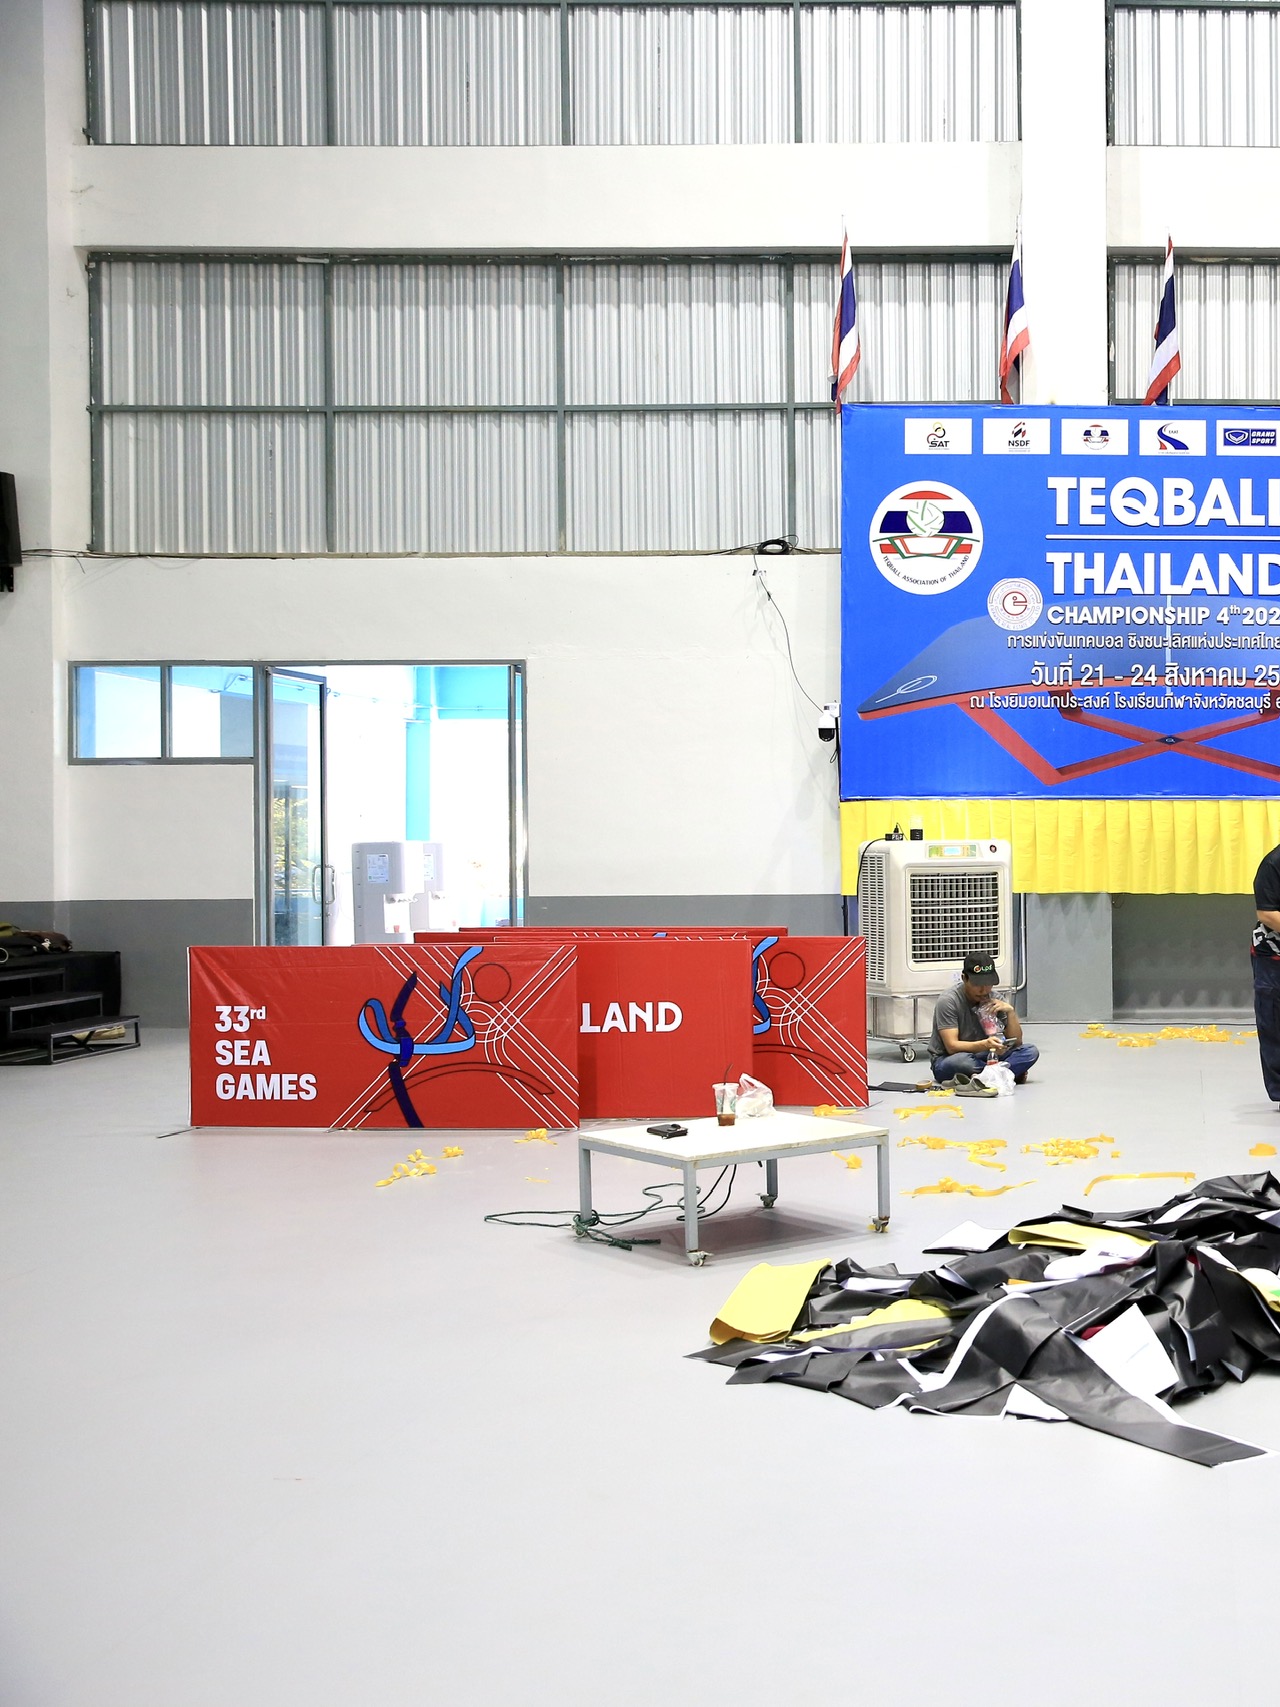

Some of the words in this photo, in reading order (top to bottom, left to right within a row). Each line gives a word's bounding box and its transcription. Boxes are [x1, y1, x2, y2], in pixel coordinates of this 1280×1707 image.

[929, 439, 950, 448] SAT
[1008, 440, 1030, 448] NSDF
[902, 575, 939, 586] ASSOCIATION
[948, 555, 970, 578] THAILAND
[1047, 605, 1211, 626] CHAMPIONSHIP
[1216, 604, 1241, 626] 4th
[1007, 631, 1124, 649] การแข่งขันเทคบอล
[1031, 654, 1074, 687] วันที่
[1080, 664, 1105, 687] 21
[1131, 664, 1158, 687] 24
[1164, 662, 1246, 688] สิงหาคม
[970, 696, 985, 709] ณ
[988, 691, 1110, 710] โรงยิมอเนกประสงค์
[1114, 691, 1271, 714] โรงเรียนกีฬาจังหวัดชลบุรี
[214, 1005, 267, 1033] 33rd
[580, 1001, 683, 1033] LAND
[215, 1039, 272, 1066] SEA
[215, 1073, 318, 1101] GAMES
